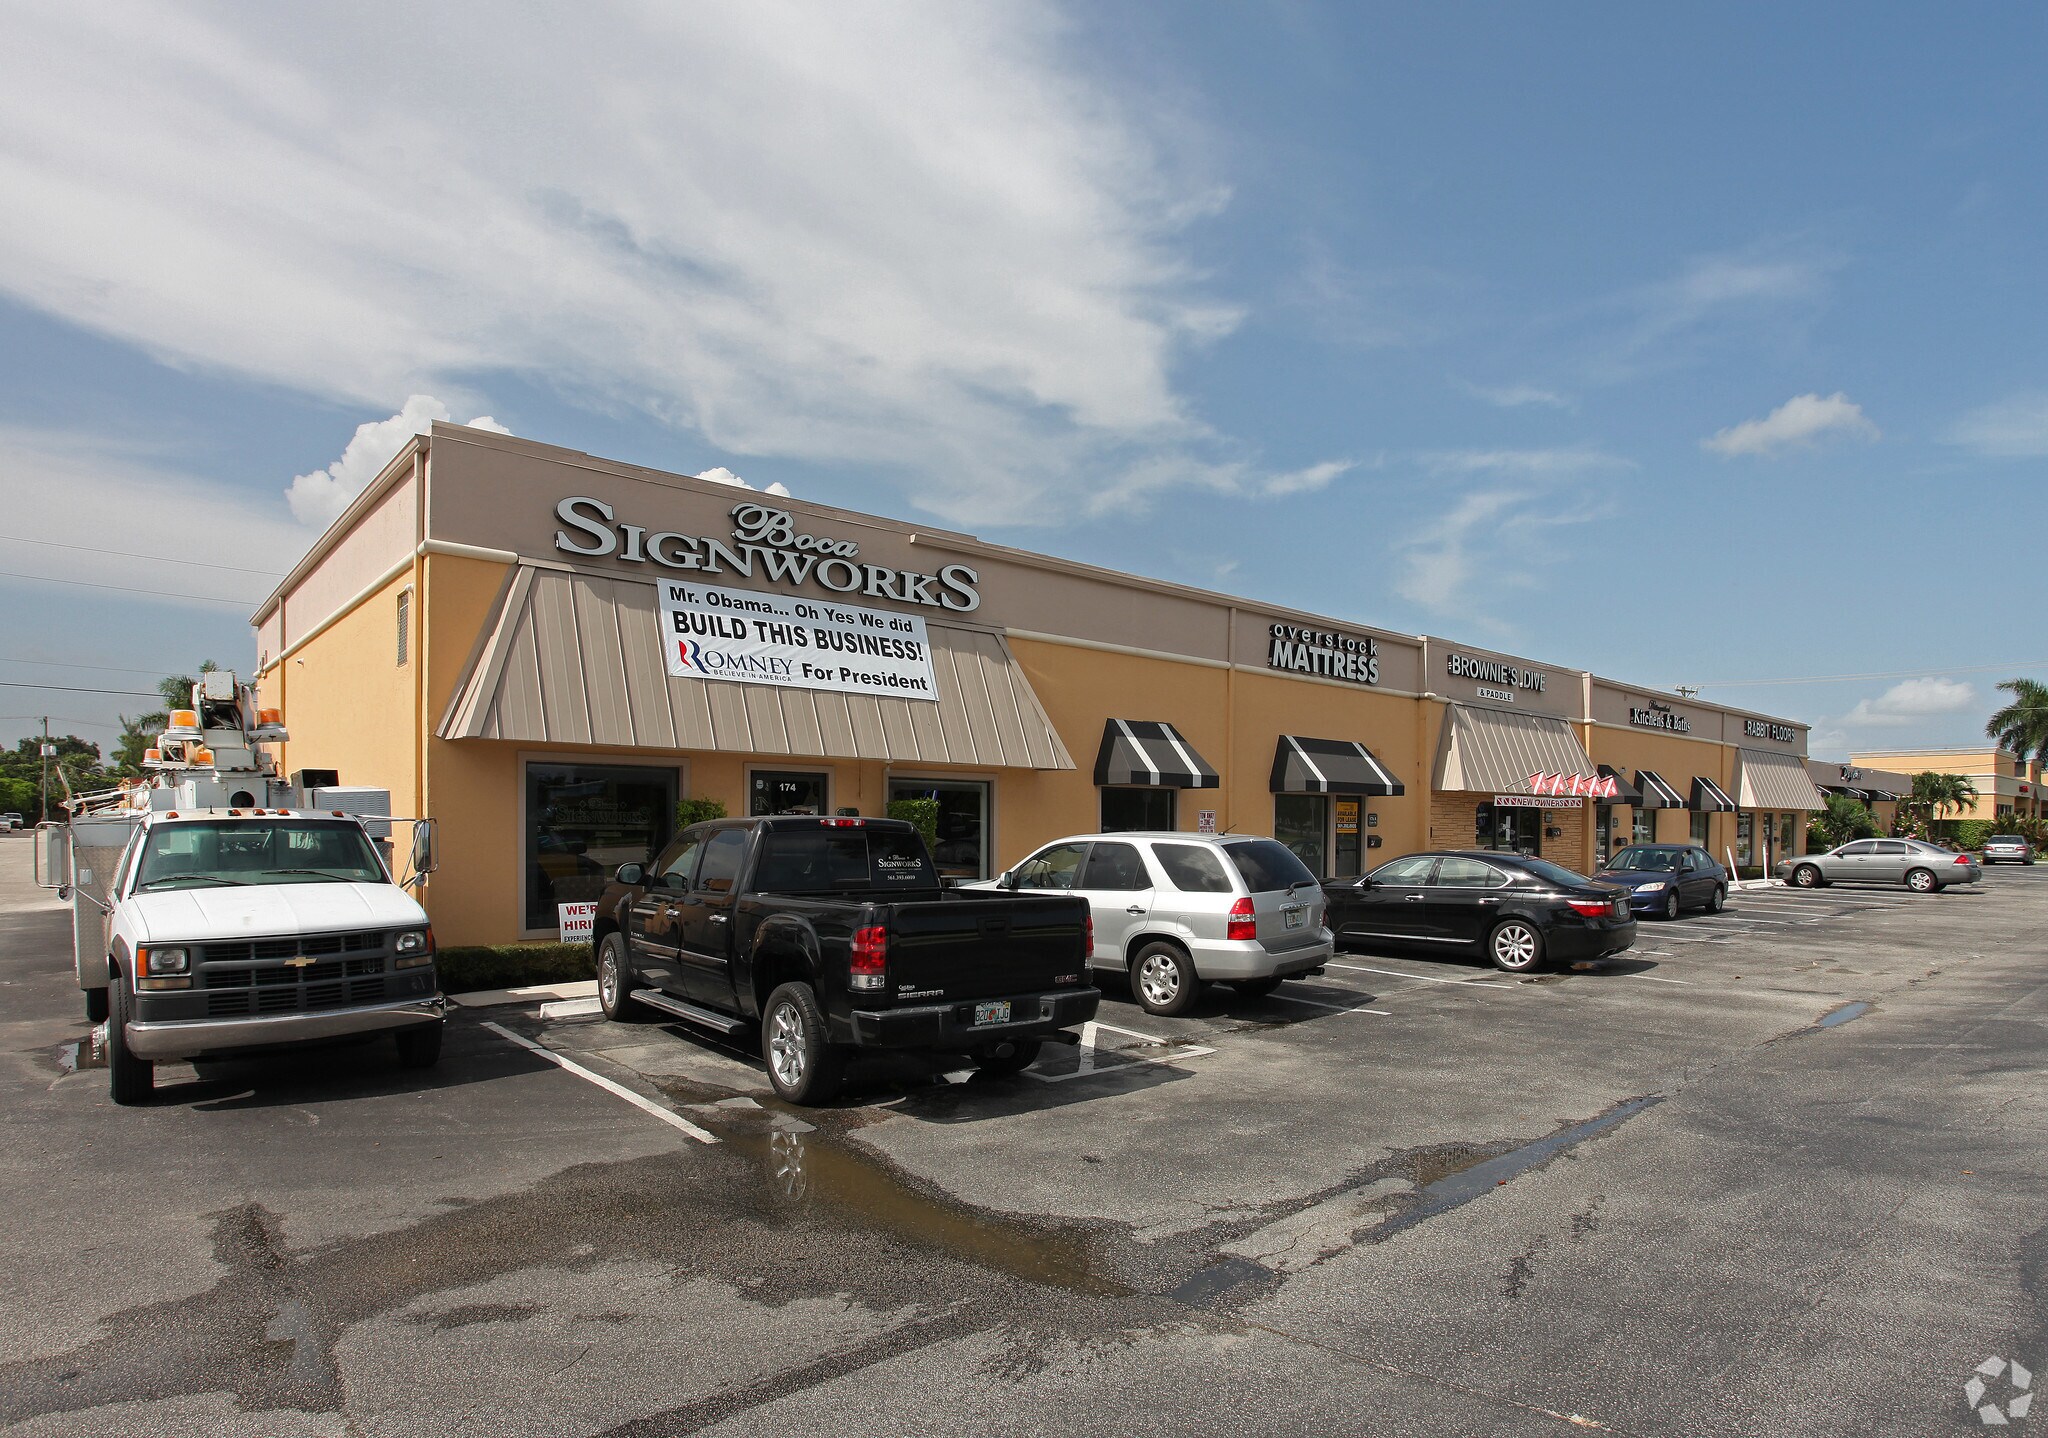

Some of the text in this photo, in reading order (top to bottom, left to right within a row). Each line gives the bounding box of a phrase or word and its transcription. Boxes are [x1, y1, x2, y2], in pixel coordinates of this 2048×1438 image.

[728, 502, 860, 559] Boca
[555, 496, 981, 613] SIGNWORKS
[669, 586, 913, 633] Mr. Obama... Oh Yes We did
[672, 611, 925, 662] BUILD THIS BUSINESS!
[1270, 623, 1378, 657] overstock
[678, 639, 928, 691] ROMNEY For President
[1270, 639, 1379, 684] MATTRESS
[1449, 654, 1546, 692] BROWNIE'S DIVE
[713, 669, 792, 682] BELIEVE IN AMERICA
[1480, 688, 1511, 700] & PADDLE
[1632, 708, 1691, 732] Kitchens & Baths
[1745, 720, 1795, 742] RABBIT FLOORS
[779, 783, 797, 792] 174
[1517, 798, 1533, 806] NEW
[878, 858, 922, 868] SIGNWORKS
[566, 905, 599, 915] WE'R
[564, 920, 592, 931] HIRI
[898, 989, 944, 1000] SIERRA
